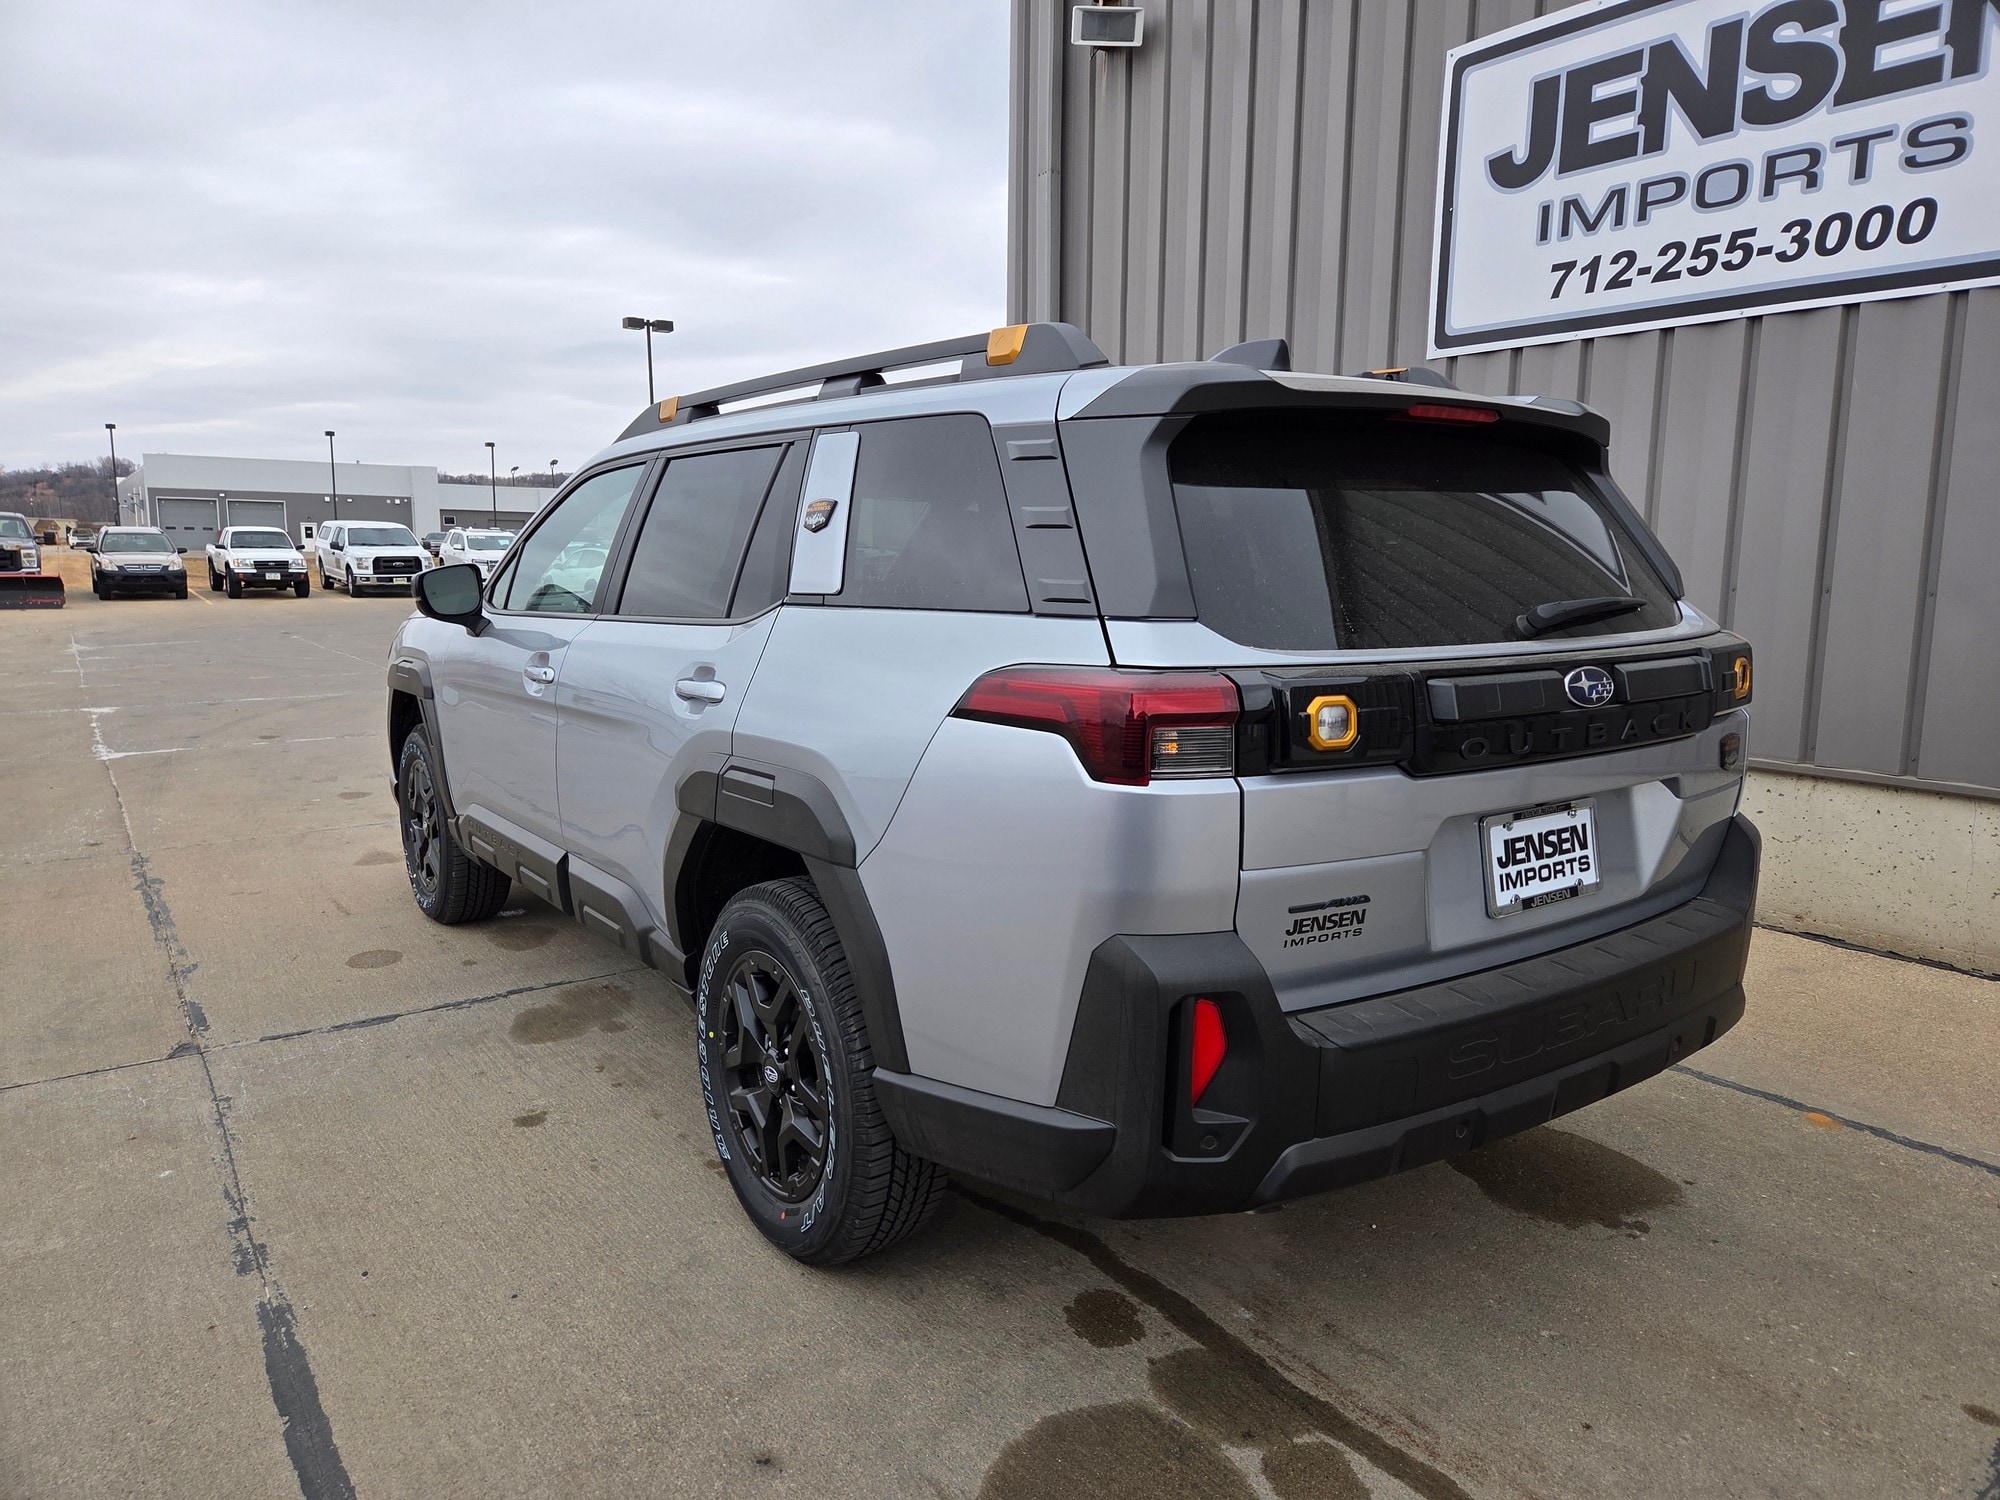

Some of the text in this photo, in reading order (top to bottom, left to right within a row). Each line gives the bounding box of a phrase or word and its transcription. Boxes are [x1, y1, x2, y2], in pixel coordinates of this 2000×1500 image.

[1538, 115, 1970, 244] IMPORTS
[1549, 196, 1939, 300] 712-255-3000
[1460, 708, 1696, 760] OUTBACK
[1497, 823, 1589, 869] JENSEN
[1499, 855, 1591, 892] IMPORTS
[1285, 908, 1367, 936] JENSEN
[1531, 889, 1571, 908] JENSEN
[1283, 927, 1363, 948] IMPORTS
[1448, 960, 1697, 1080] SUBARU
[698, 930, 731, 1160] BRIDGESTONE
